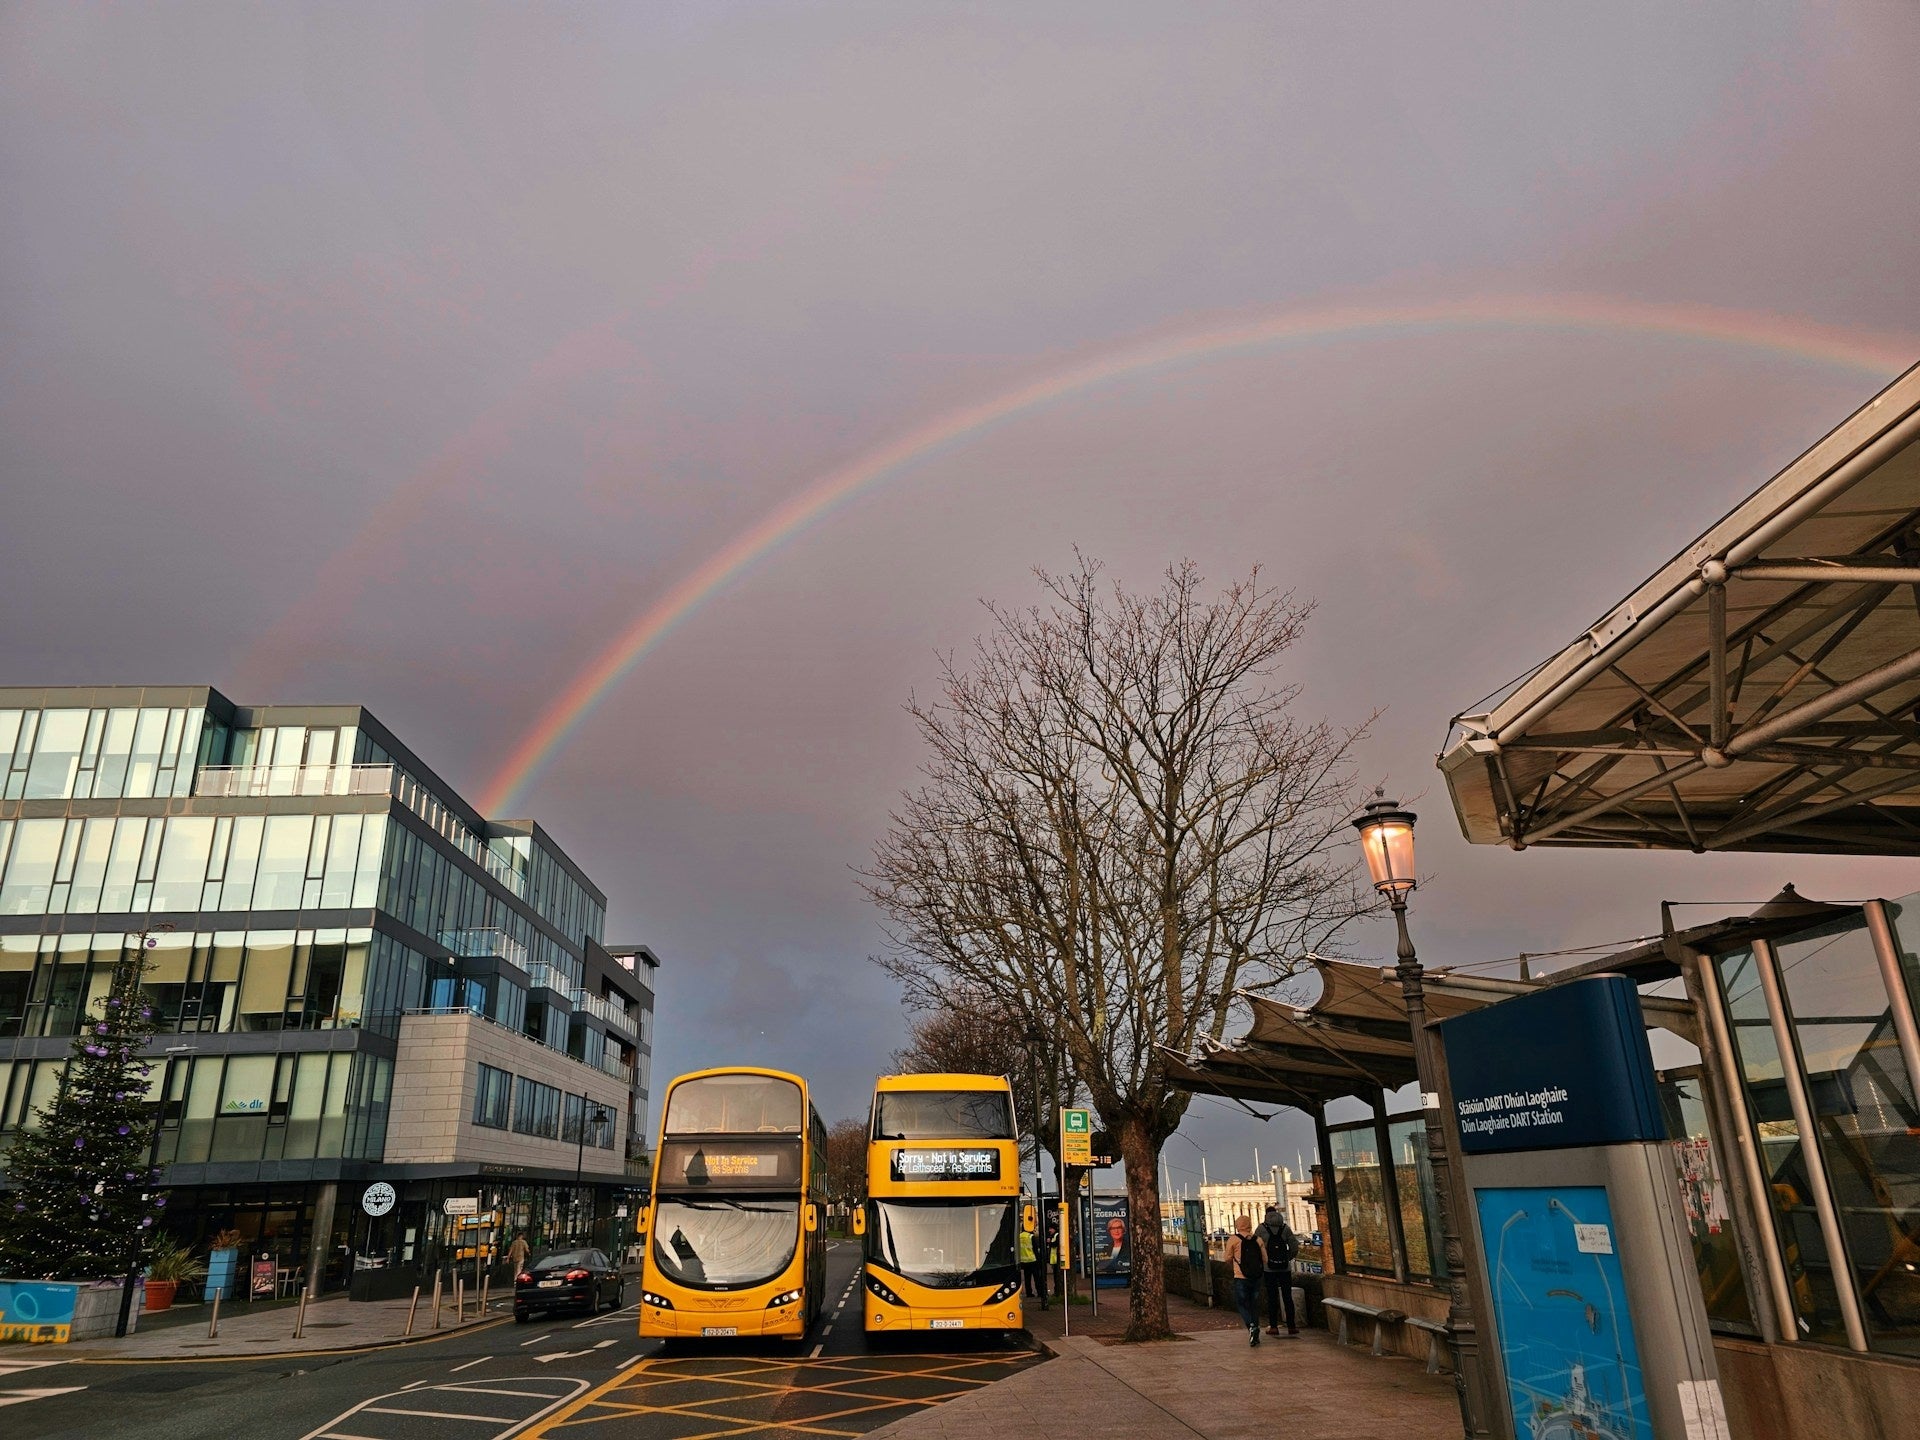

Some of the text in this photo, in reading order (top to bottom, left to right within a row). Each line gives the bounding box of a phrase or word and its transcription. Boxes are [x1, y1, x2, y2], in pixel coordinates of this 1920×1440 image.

[249, 1099, 263, 1109] dlr
[1484, 1095, 1504, 1112] DART
[1504, 1091, 1526, 1109] Dhún
[1525, 1086, 1568, 1109] Laoghaire
[1461, 1108, 1563, 1135] Dún Laoghaire DART Station
[705, 1156, 720, 1165] Not
[731, 1156, 758, 1165] Service
[899, 1152, 923, 1164] Sorry
[931, 1152, 947, 1163] Not
[949, 1152, 957, 1163] in
[959, 1152, 991, 1163] Service
